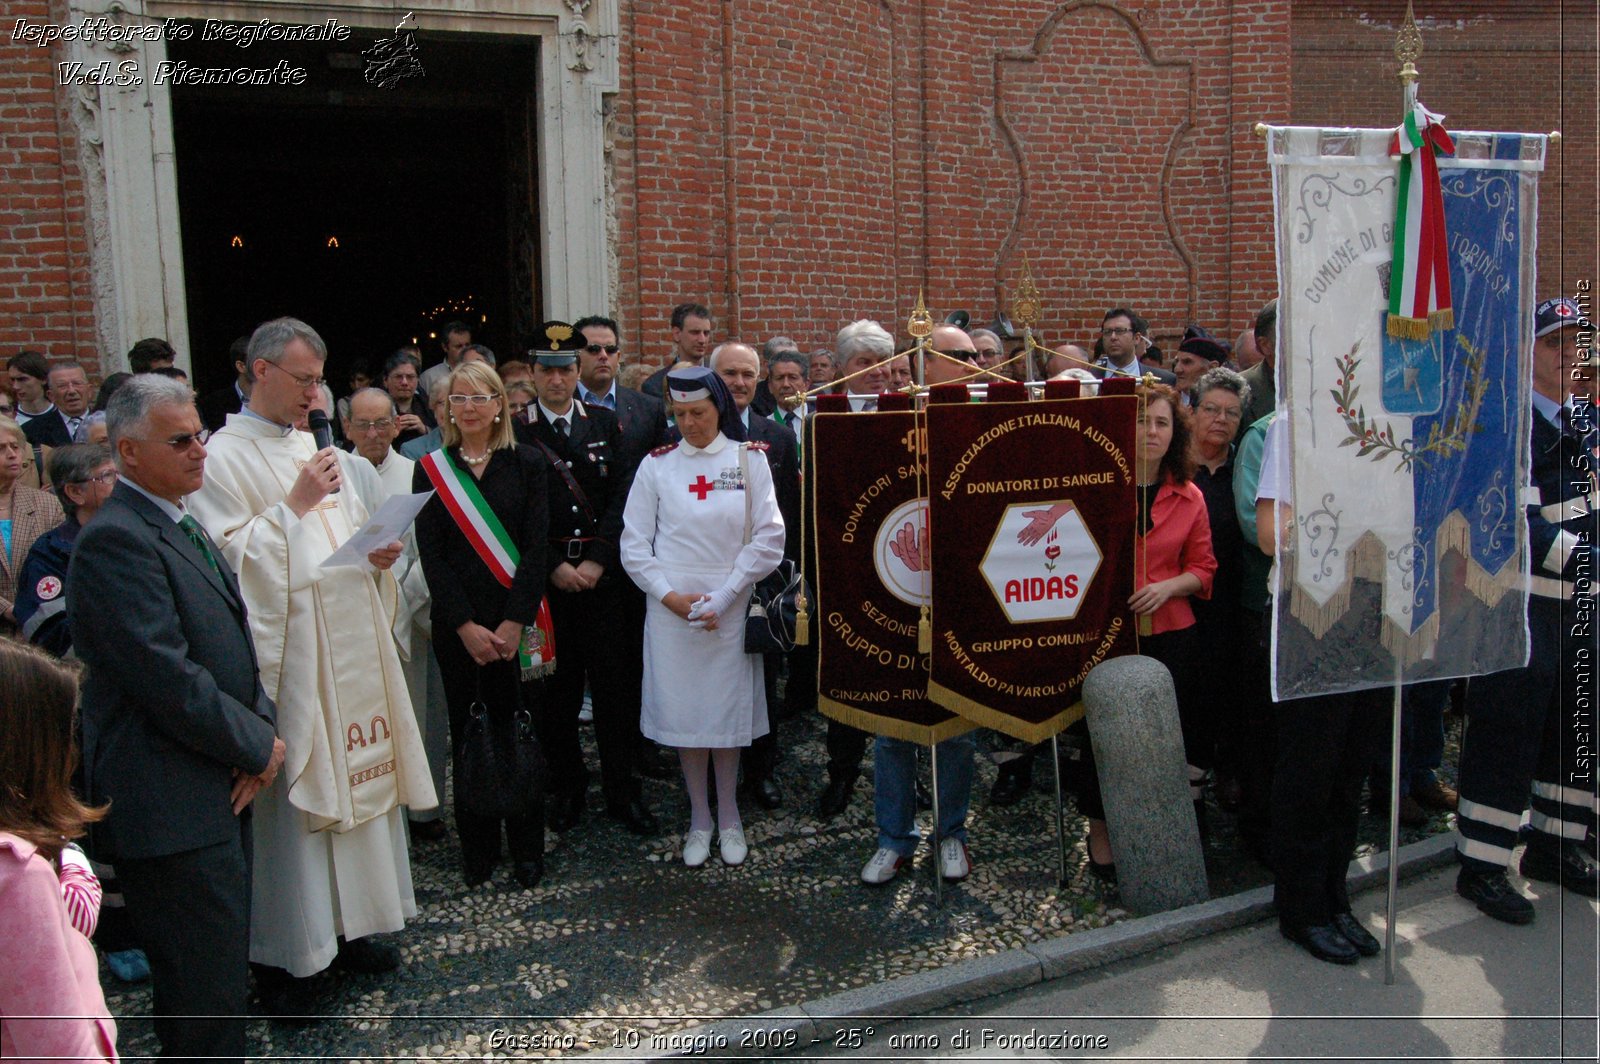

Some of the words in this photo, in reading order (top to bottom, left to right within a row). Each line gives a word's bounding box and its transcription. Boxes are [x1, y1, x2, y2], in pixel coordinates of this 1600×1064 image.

[1304, 237, 1358, 304] COMUNE
[1358, 226, 1377, 252] DI
[941, 417, 1018, 500] ASSOCIAZIONE
[1014, 413, 1081, 432] ITALIANA
[1083, 425, 1133, 485] AUTONOMA
[967, 478, 1040, 494] DONATORI
[1043, 476, 1060, 489] DI
[1062, 471, 1115, 487] SANGUE
[842, 474, 892, 543] DONATORI
[1004, 574, 1079, 603] AIDAS
[828, 611, 892, 665] GRUPPO
[897, 654, 915, 670] DI
[861, 600, 918, 638] SEZIONE
[943, 630, 998, 688] MONTALDO
[997, 681, 1066, 697] PAVAROLO
[971, 637, 1033, 652] GRUPPO
[830, 688, 890, 702] CINZANO
